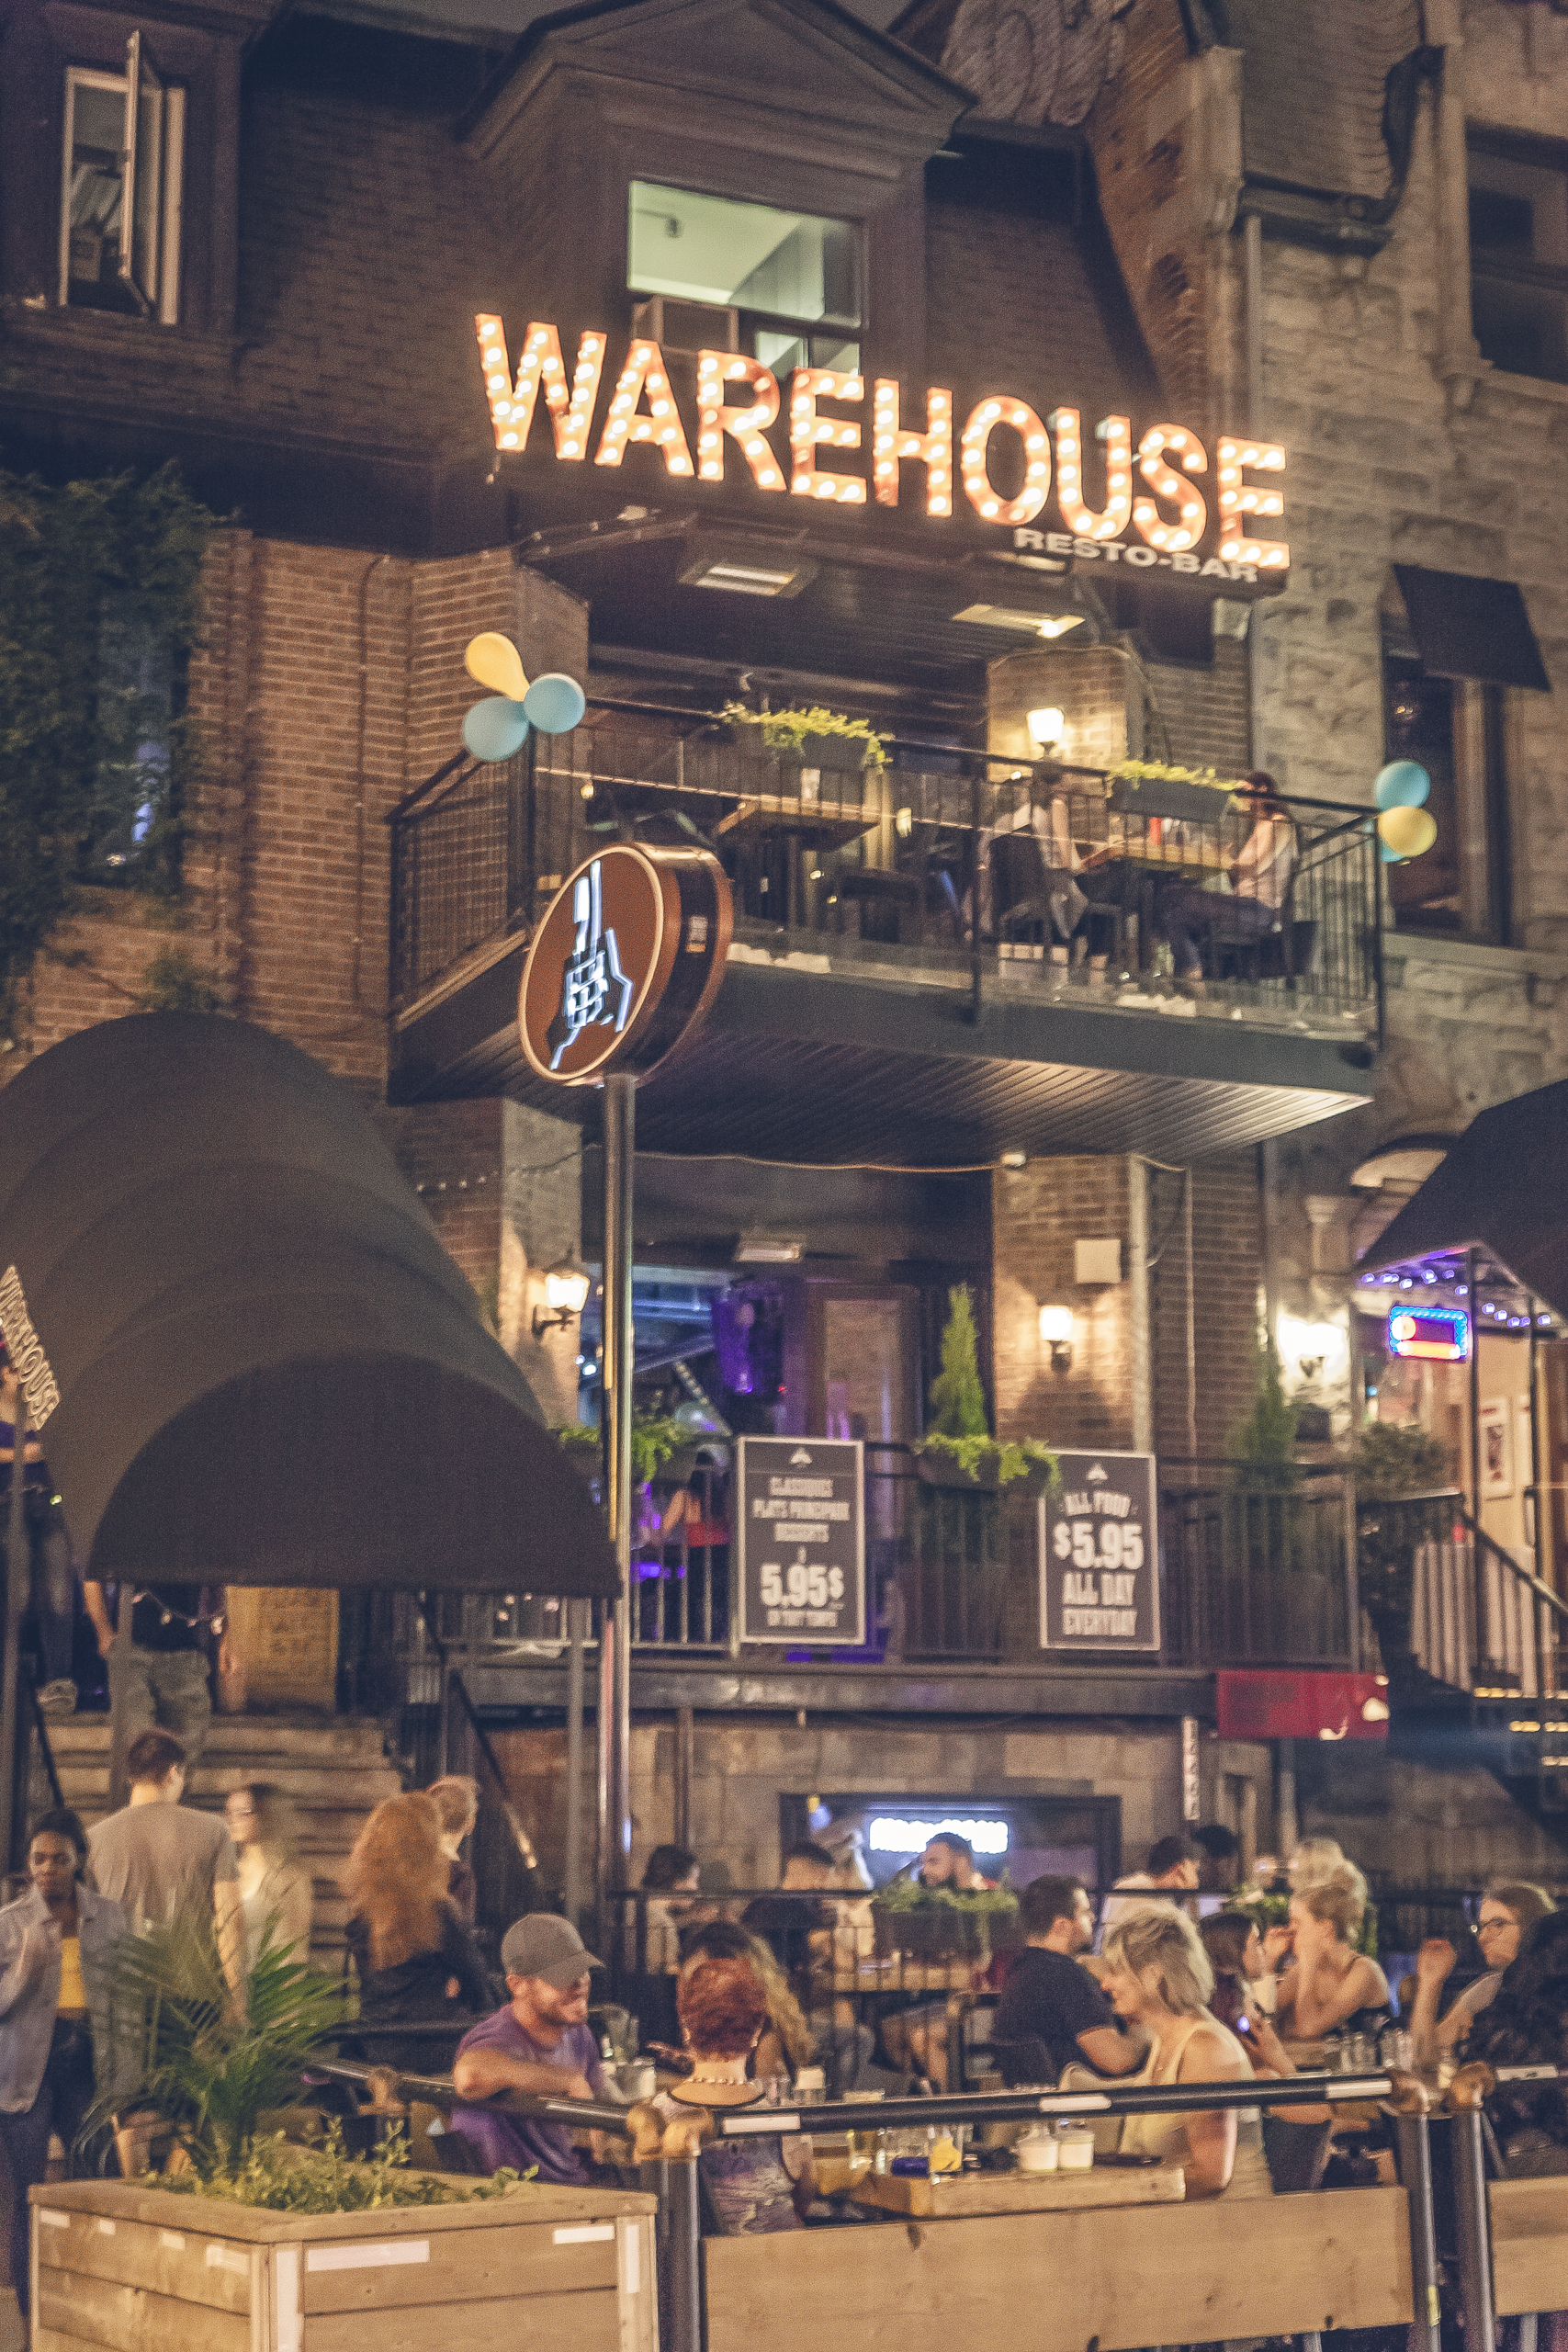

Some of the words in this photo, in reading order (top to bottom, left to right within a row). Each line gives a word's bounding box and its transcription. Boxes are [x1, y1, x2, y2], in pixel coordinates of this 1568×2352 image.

[475, 313, 1291, 568] WAREHOUSE
[1014, 526, 1259, 582] RESTO-BAR
[1054, 1521, 1145, 1570] $5.95
[1062, 1572, 1099, 1605] ALL
